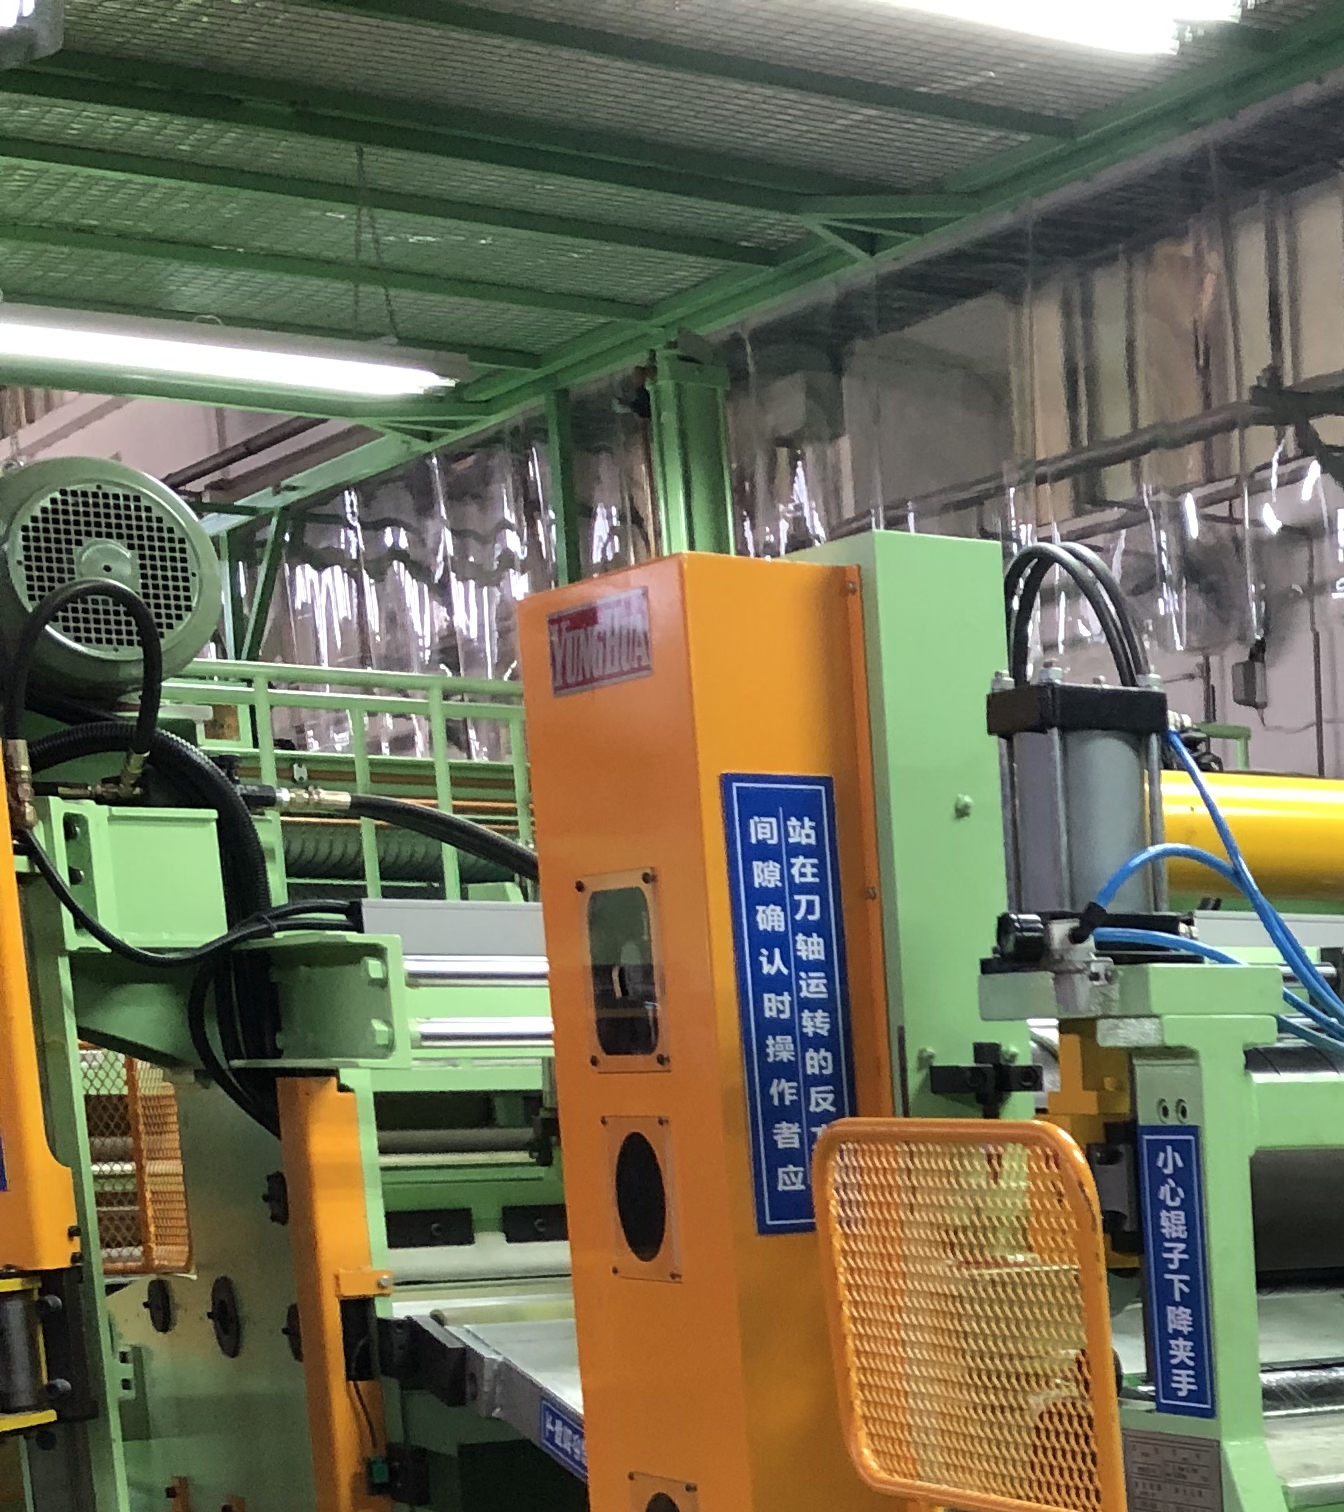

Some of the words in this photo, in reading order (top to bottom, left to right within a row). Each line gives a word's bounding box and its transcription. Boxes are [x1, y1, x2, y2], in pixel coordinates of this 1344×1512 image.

[750, 816, 806, 1191] 间隙确认时操作者应
[1156, 1145, 1198, 1397] 小心辊子下降夹手
